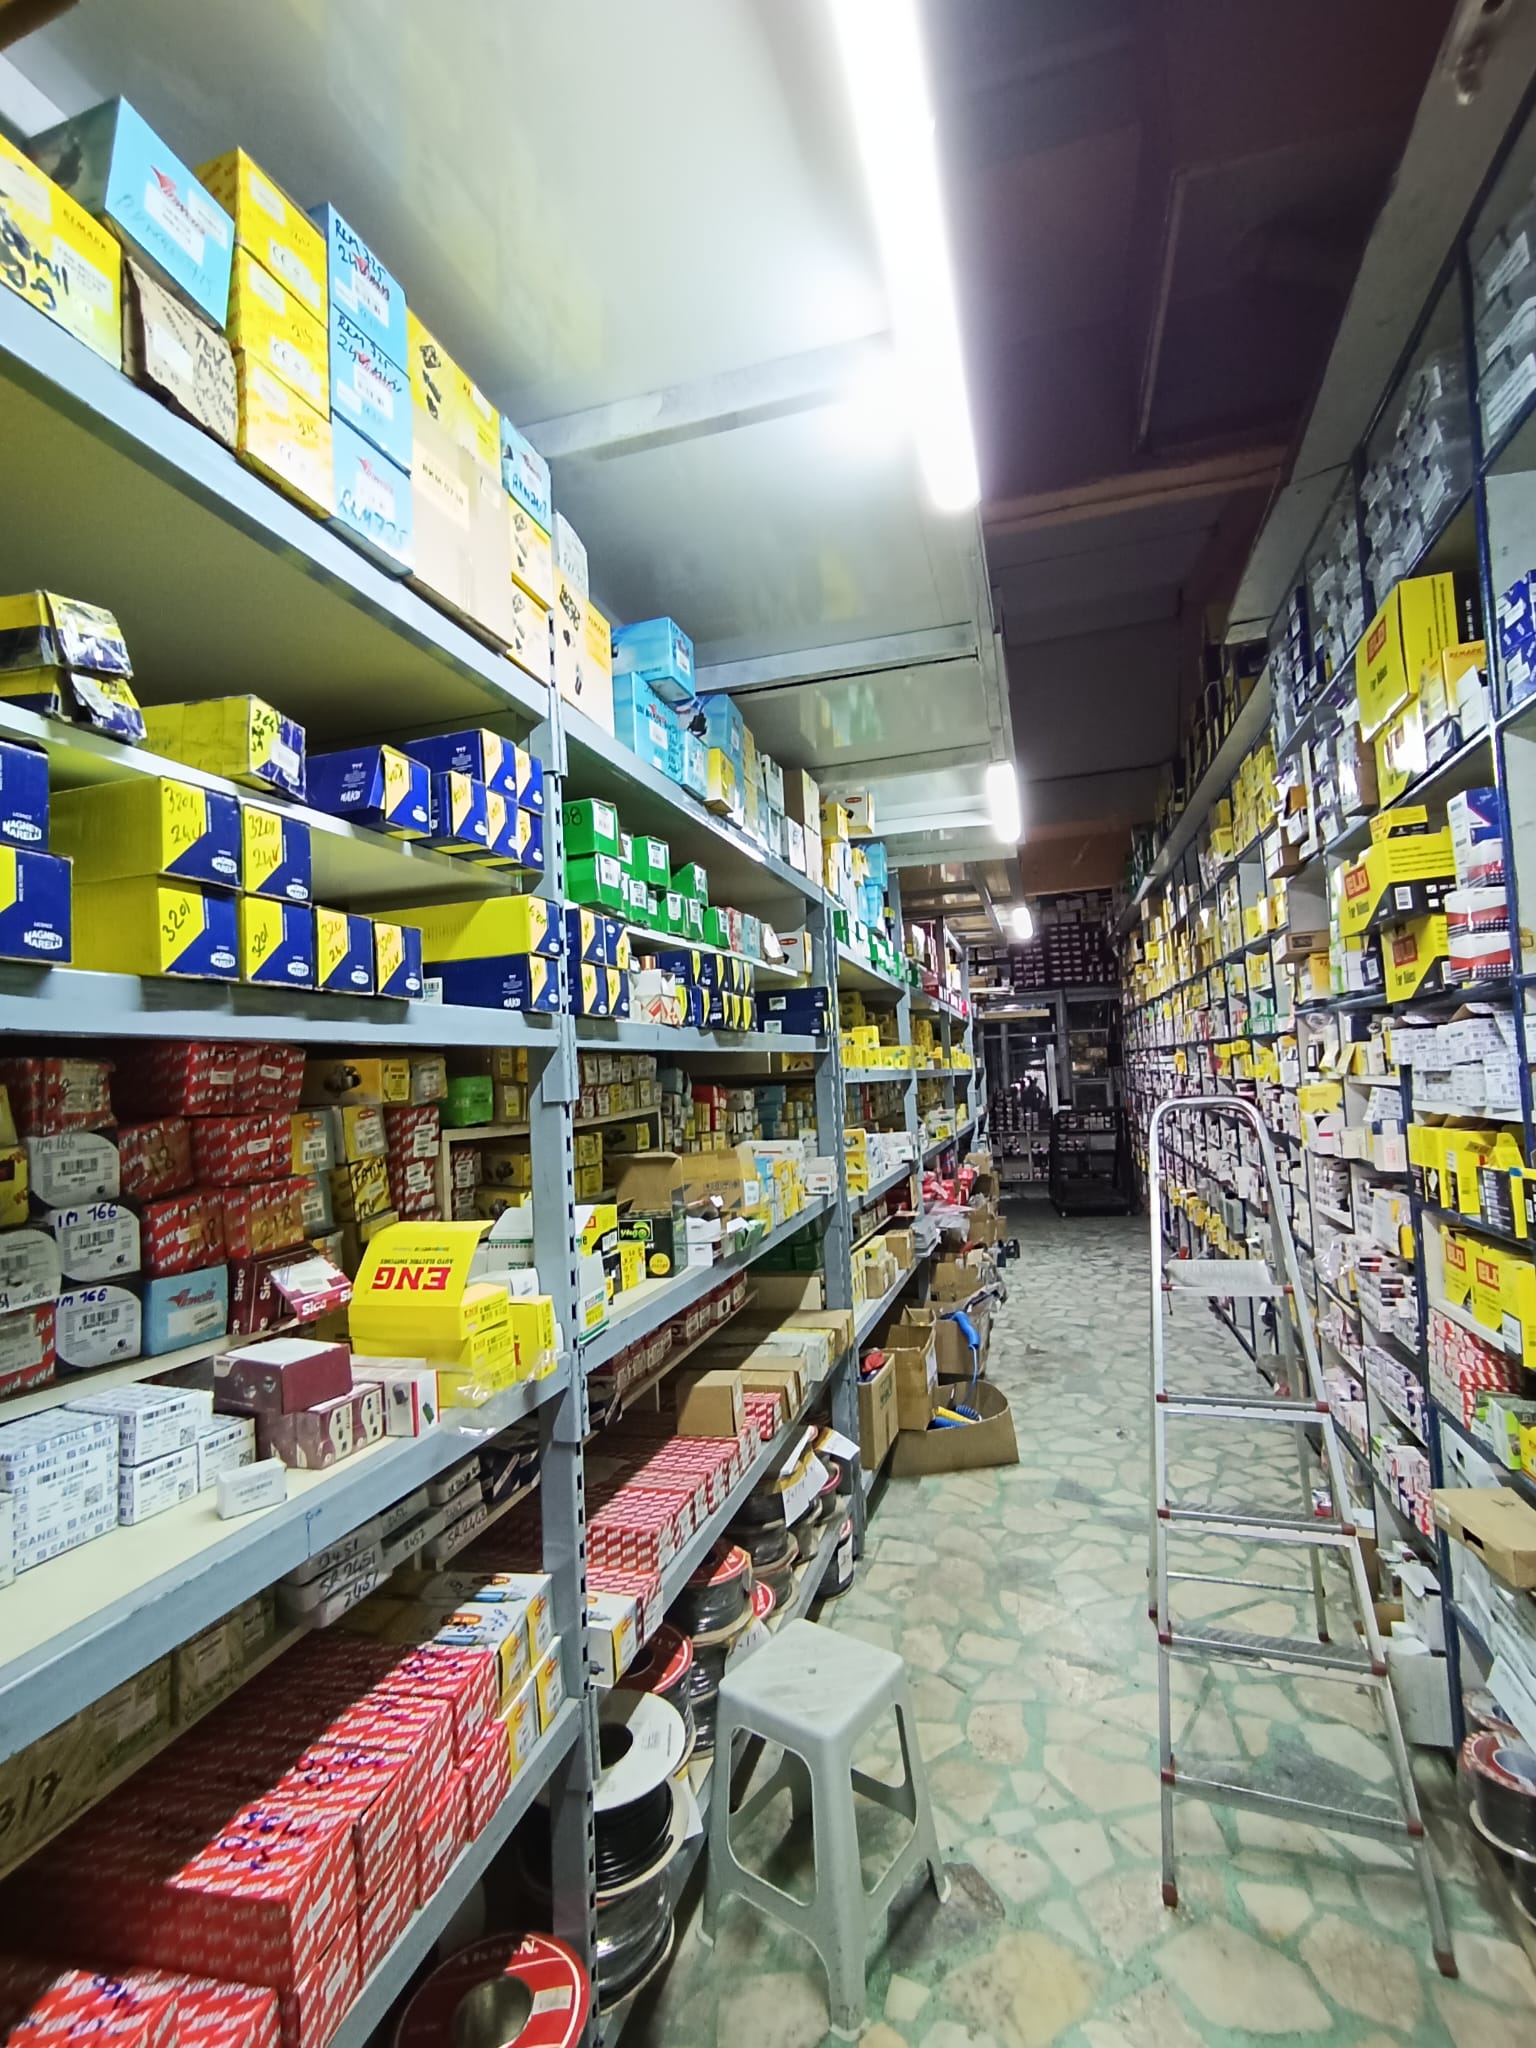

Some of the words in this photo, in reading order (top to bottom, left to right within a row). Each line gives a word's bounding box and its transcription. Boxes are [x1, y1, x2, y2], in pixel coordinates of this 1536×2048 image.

[370, 1266, 452, 1291] ENG
[18, 1456, 58, 1478] SANEL
[18, 1527, 59, 1550] SANEL
